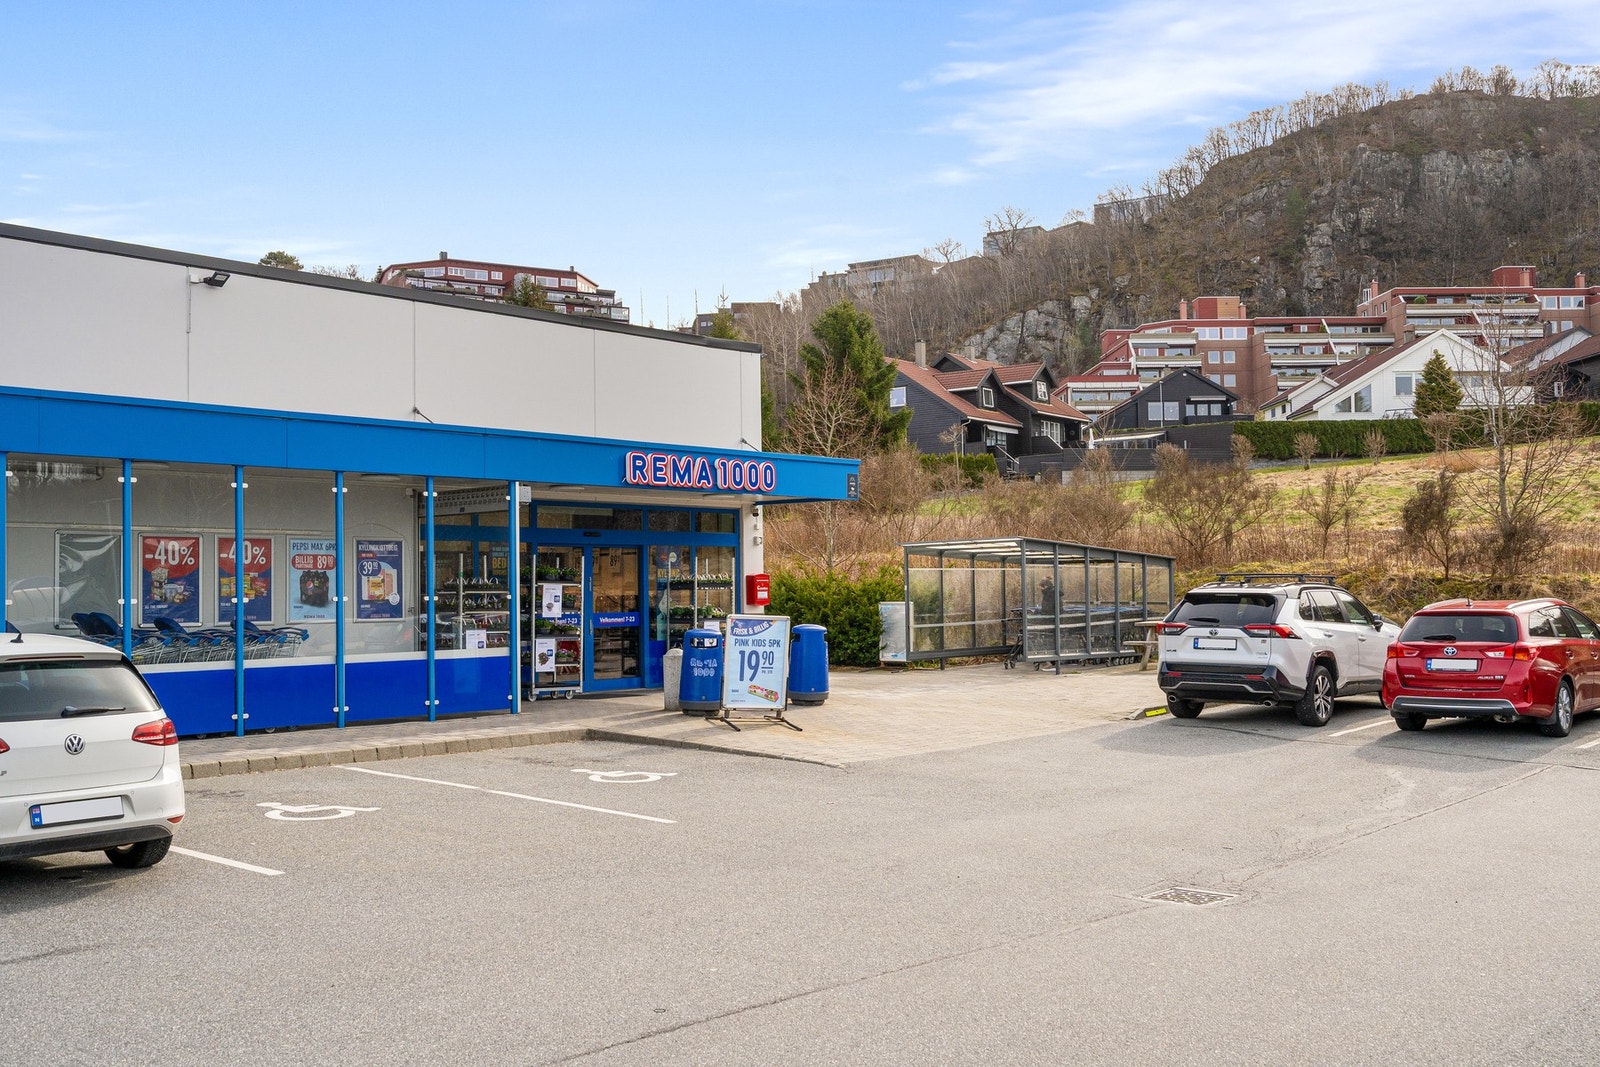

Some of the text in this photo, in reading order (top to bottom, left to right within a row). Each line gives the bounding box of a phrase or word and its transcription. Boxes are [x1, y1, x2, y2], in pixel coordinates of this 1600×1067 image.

[626, 451, 777, 492] REMA 1000
[145, 540, 195, 565] -40%
[292, 542, 310, 551] PEPSI
[311, 543, 324, 551] MAX
[295, 556, 314, 564] BILLIG
[317, 556, 327, 569] 89
[362, 561, 373, 575] 39
[733, 627, 748, 635] FRISK
[734, 638, 781, 648] PINK KIDS 5PK
[738, 650, 774, 682] 19 90
